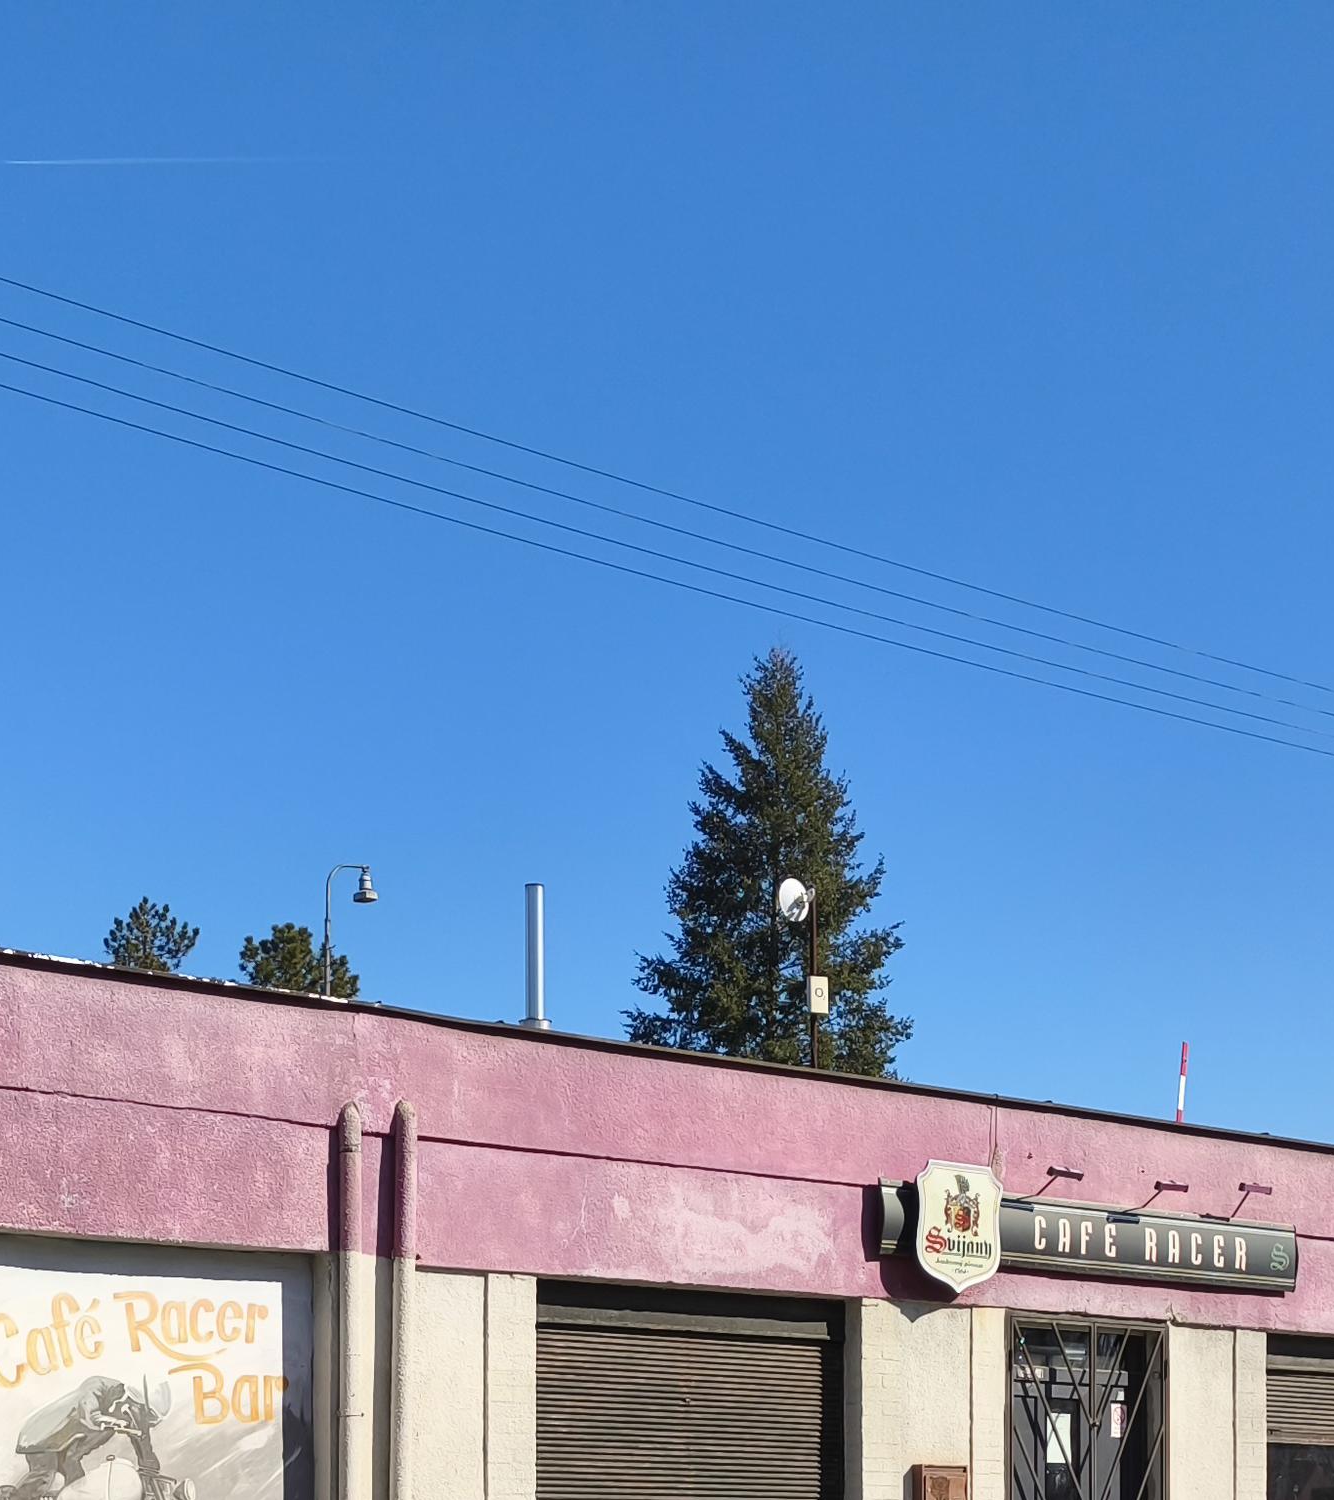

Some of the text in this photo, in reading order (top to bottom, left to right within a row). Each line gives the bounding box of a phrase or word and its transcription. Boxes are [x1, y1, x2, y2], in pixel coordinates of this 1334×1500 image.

[924, 1225, 992, 1260] Svijany
[1034, 1215, 1247, 1272] CAFE RACER
[113, 1290, 269, 1362] Racer
[168, 1362, 290, 1425] Bar
